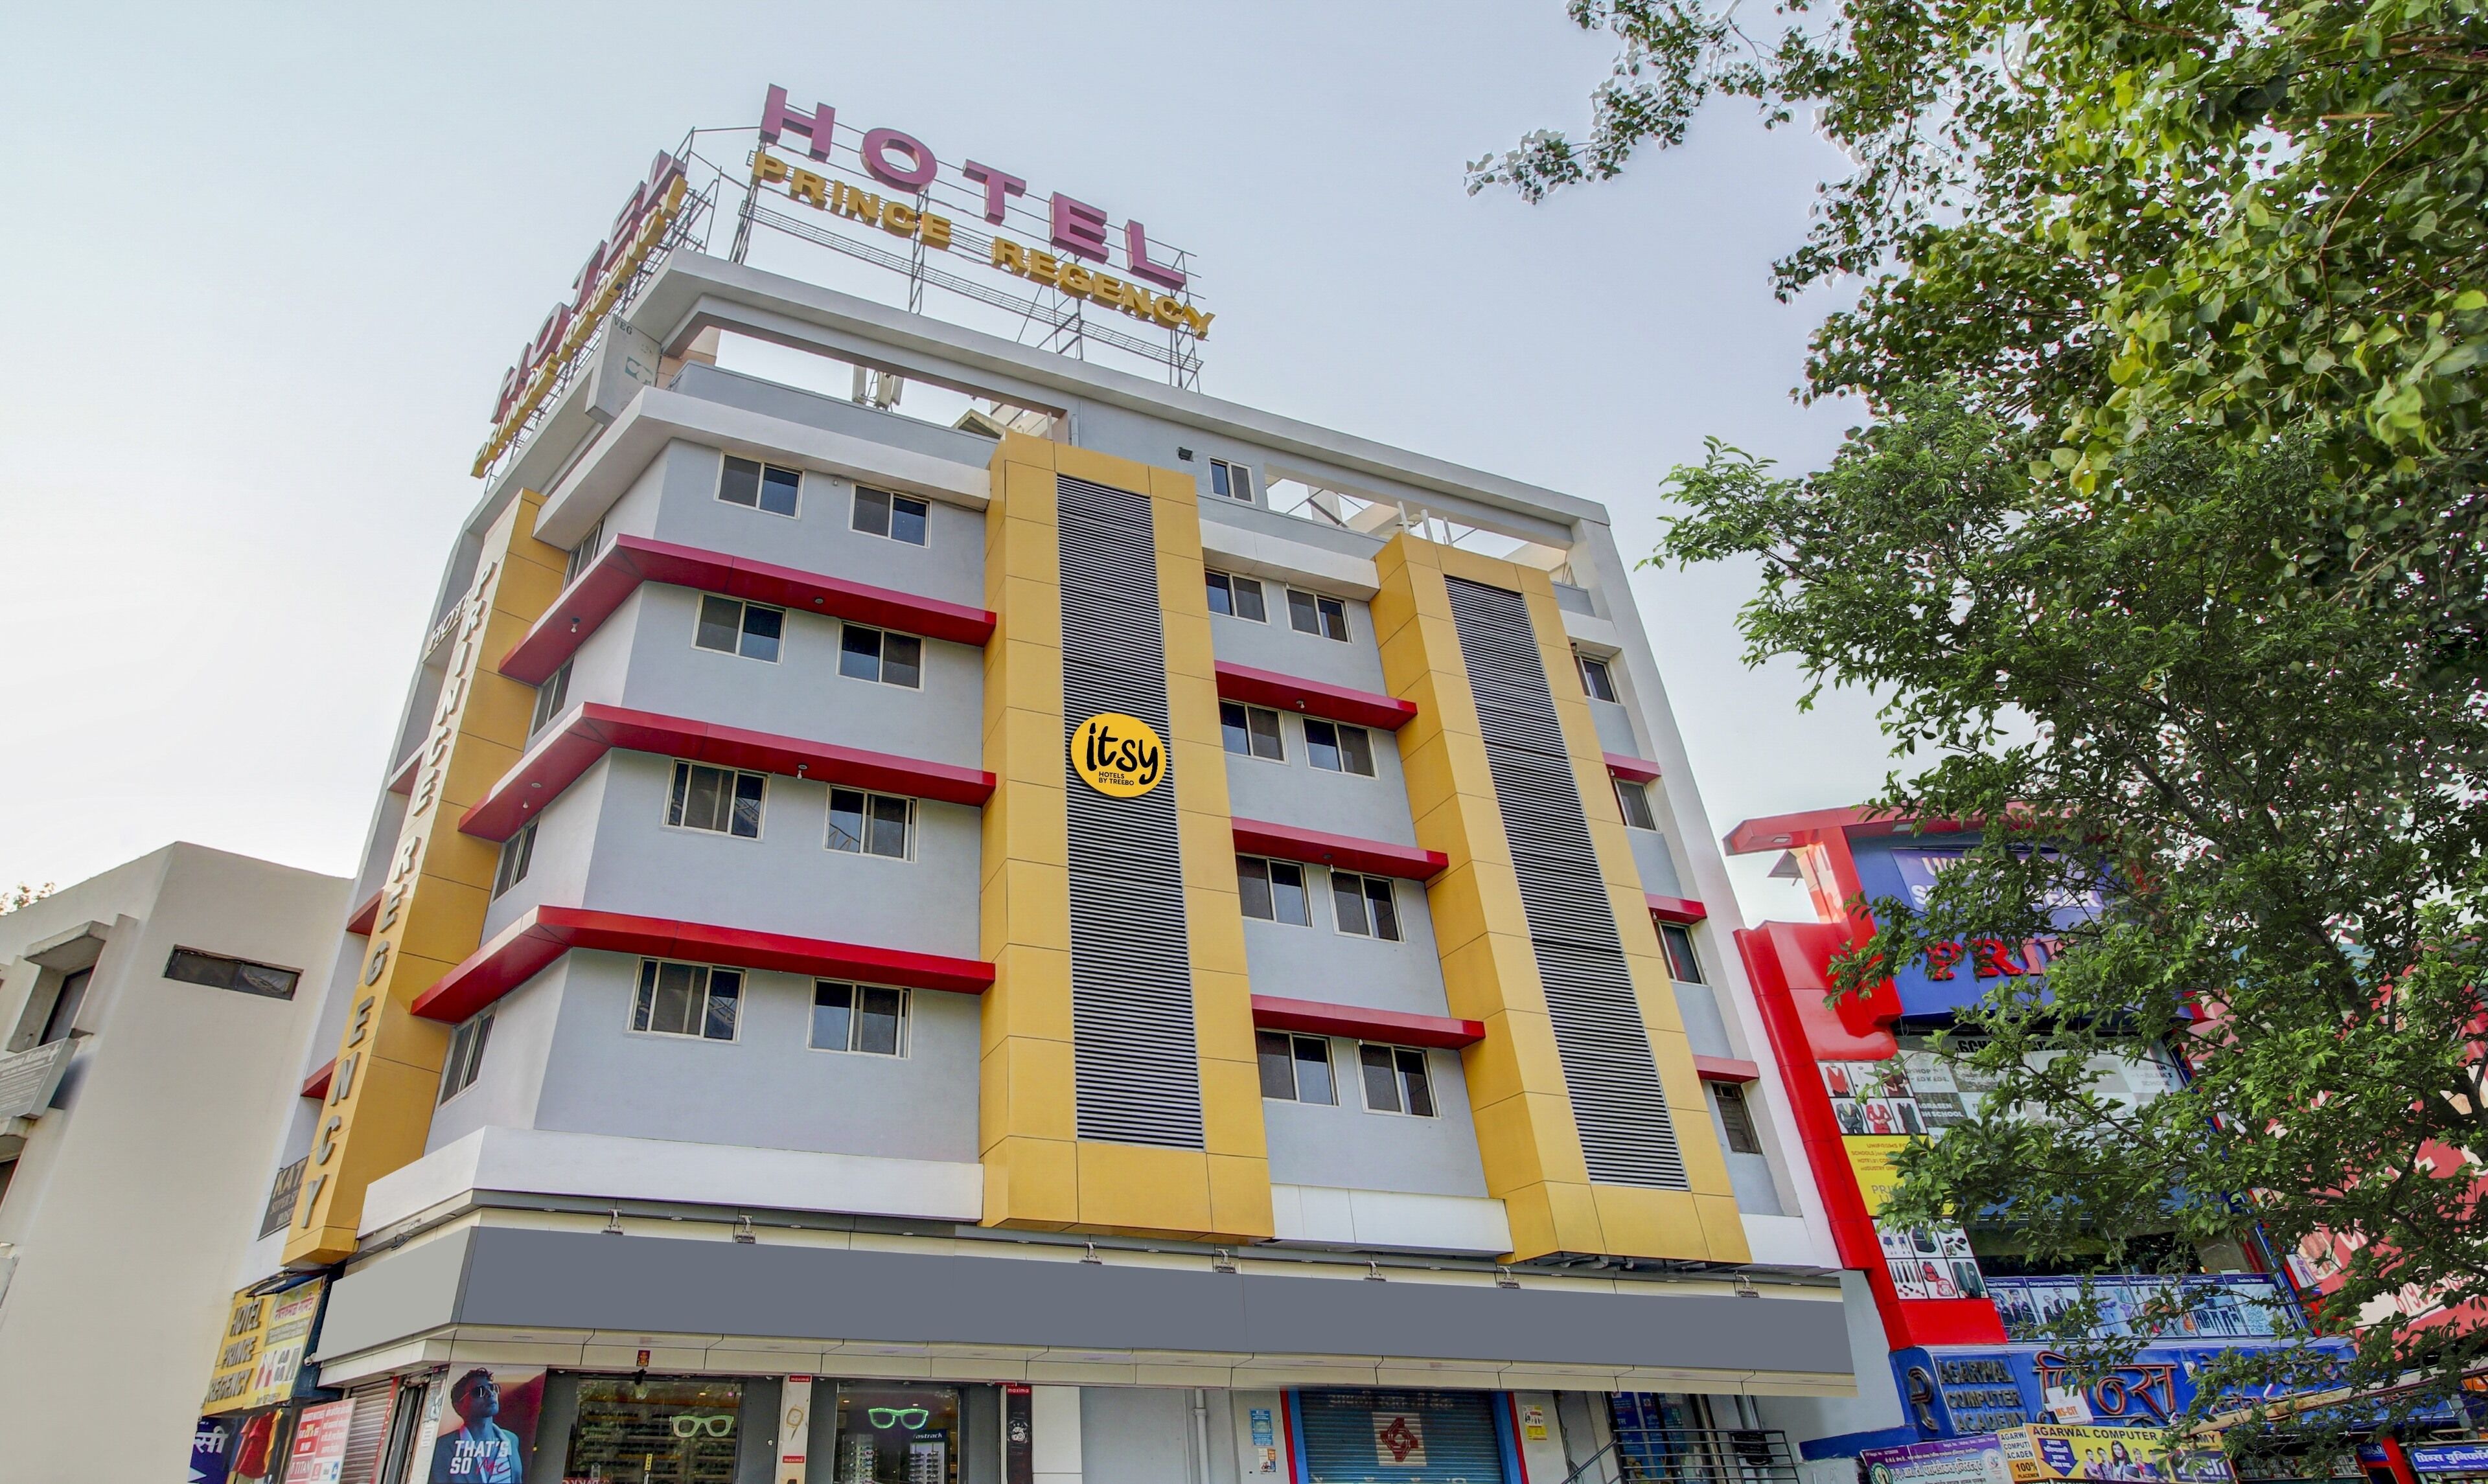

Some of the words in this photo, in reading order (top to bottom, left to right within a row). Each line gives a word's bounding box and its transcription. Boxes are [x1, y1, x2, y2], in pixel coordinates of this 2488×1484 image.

[759, 83, 1186, 290] HOTEL
[750, 150, 952, 251] PRINCE
[991, 236, 1215, 341] REGENCY
[490, 150, 685, 424] HOTEL
[411, 560, 498, 818] PRINCE
[1087, 722, 1158, 785] itsy
[1099, 771, 1125, 779] HOTELS
[300, 836, 419, 1229] REGENCY
[230, 1297, 264, 1338] HOTEL
[220, 1336, 259, 1369] PRINCE
[205, 1367, 255, 1404] REGENCY
[1938, 1360, 2015, 1384] AGARWAL
[1945, 1389, 2022, 1408] COMPUTER
[2055, 1406, 2079, 1417] MS-CIT
[1952, 1411, 2027, 1432] ACADEMY
[2033, 1426, 2091, 1438] AGARWAL
[2093, 1429, 2158, 1441] COMPUTER
[454, 1440, 512, 1457] THAT'S
[2003, 1441, 2030, 1450] COMPUT
[450, 1457, 473, 1474] SO
